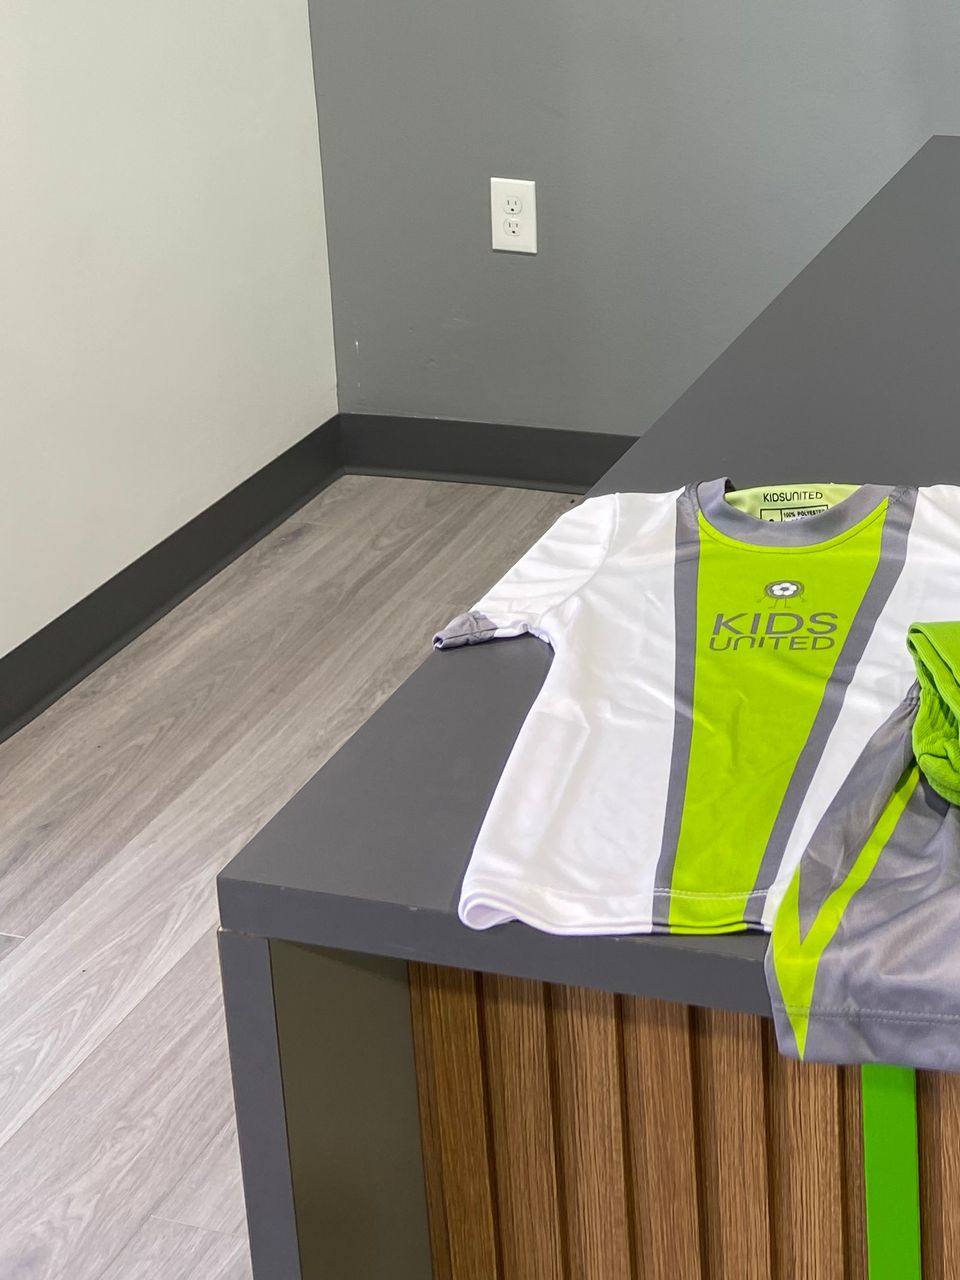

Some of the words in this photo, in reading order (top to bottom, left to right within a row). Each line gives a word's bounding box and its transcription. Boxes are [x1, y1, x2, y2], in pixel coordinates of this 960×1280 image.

[763, 491, 823, 502] KIDSUNITED
[713, 612, 838, 636] KIDS
[709, 635, 836, 652] UNITED
